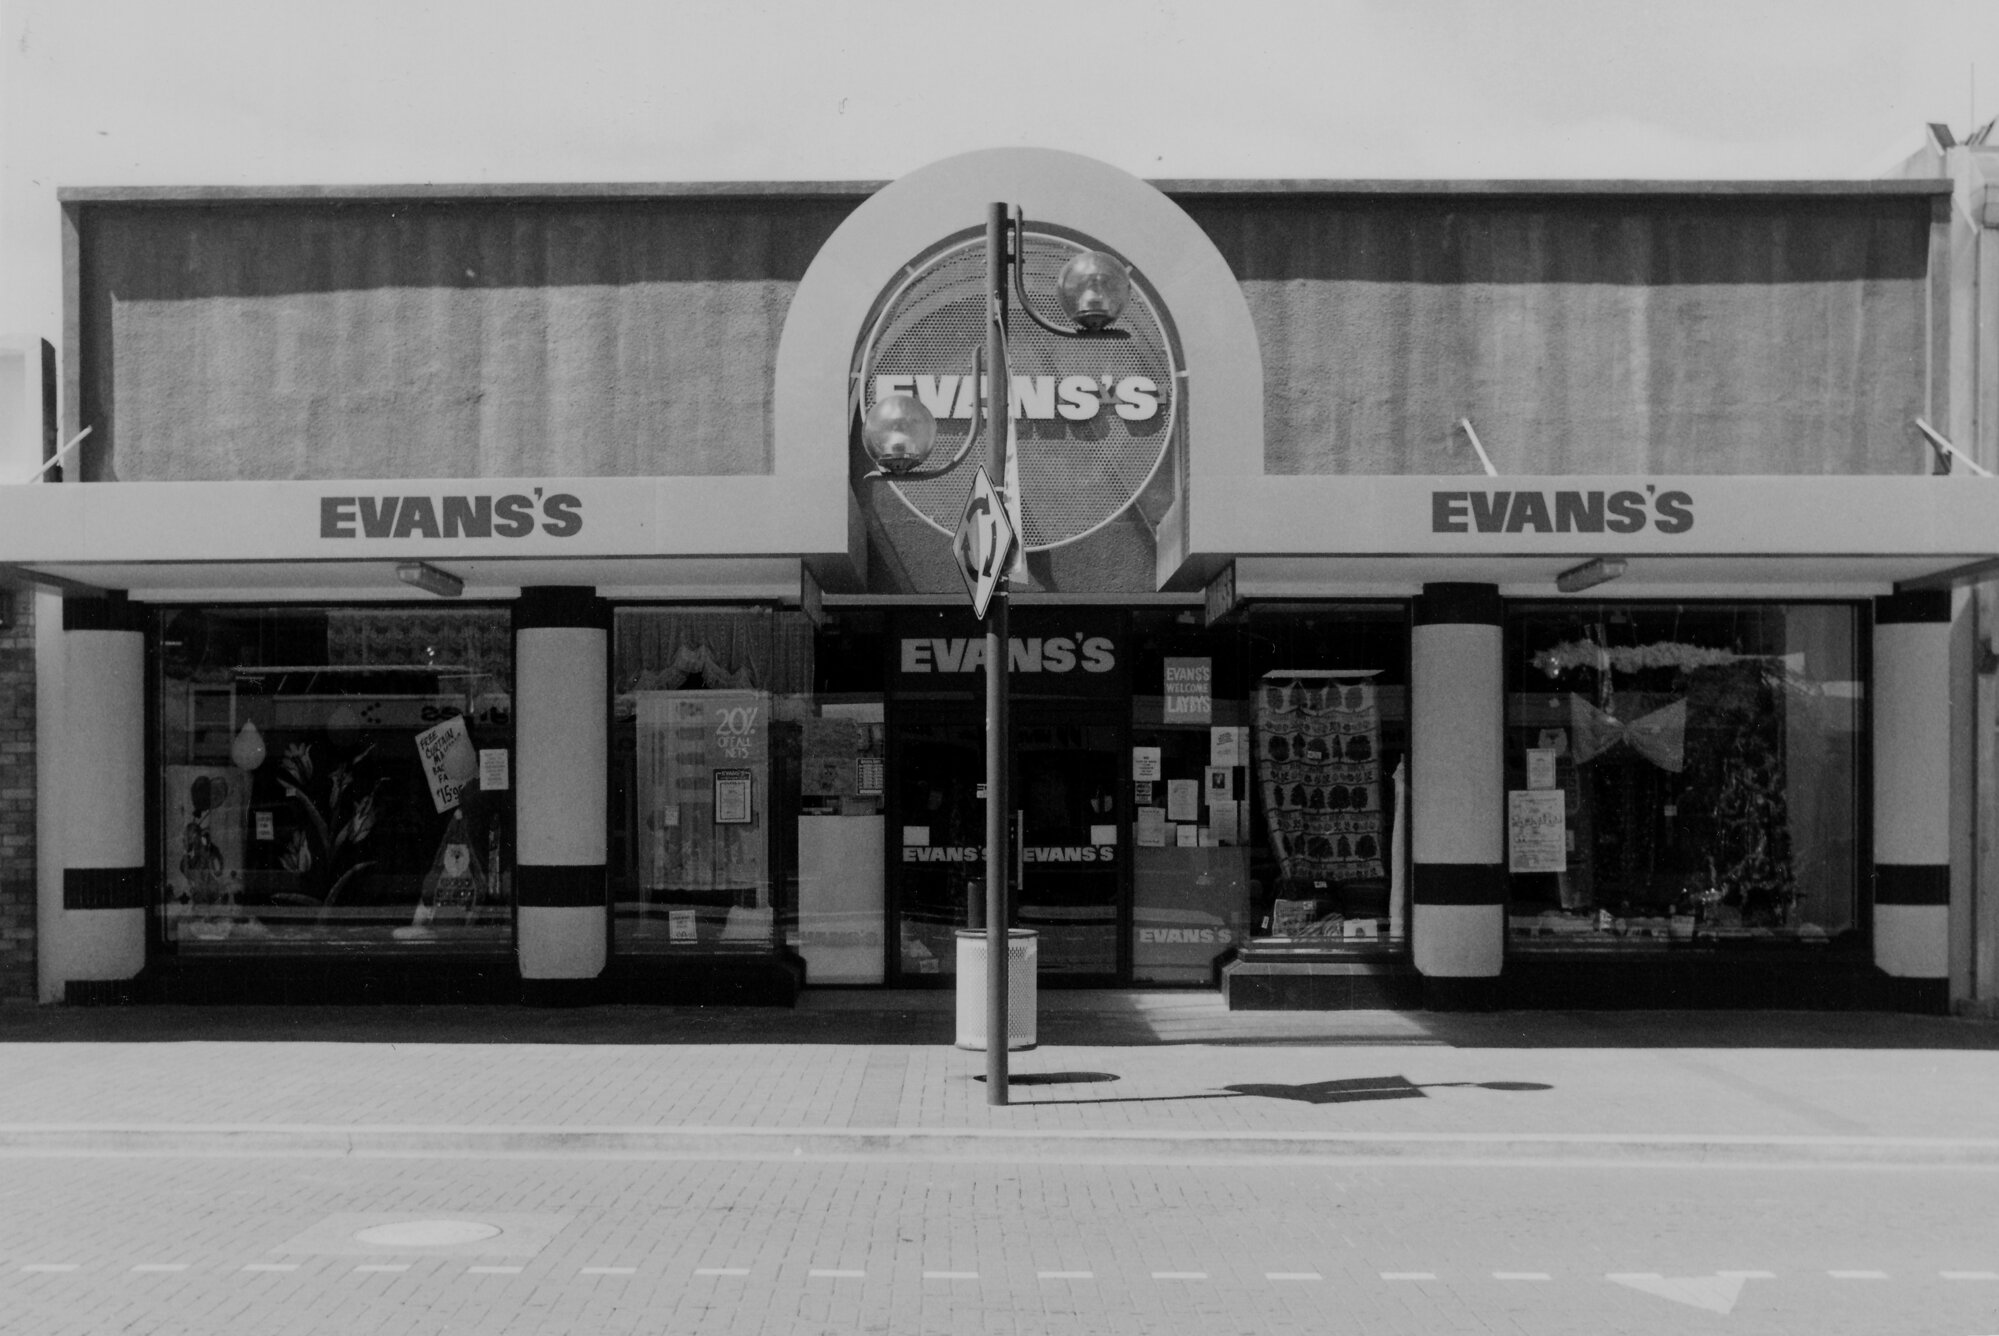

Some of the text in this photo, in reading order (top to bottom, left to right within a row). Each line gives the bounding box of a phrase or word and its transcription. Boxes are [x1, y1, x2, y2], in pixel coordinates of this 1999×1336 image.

[876, 375, 1158, 421] EVANS'S
[320, 487, 583, 538] EVANS'S
[1432, 484, 1694, 534] EVANS'S
[901, 632, 1115, 673] EVANS'S
[1166, 683, 1209, 693] WELCOME
[715, 706, 758, 735] 20%
[1022, 844, 1114, 862] EVANS'S
[1140, 926, 1232, 944] EVANS'S
